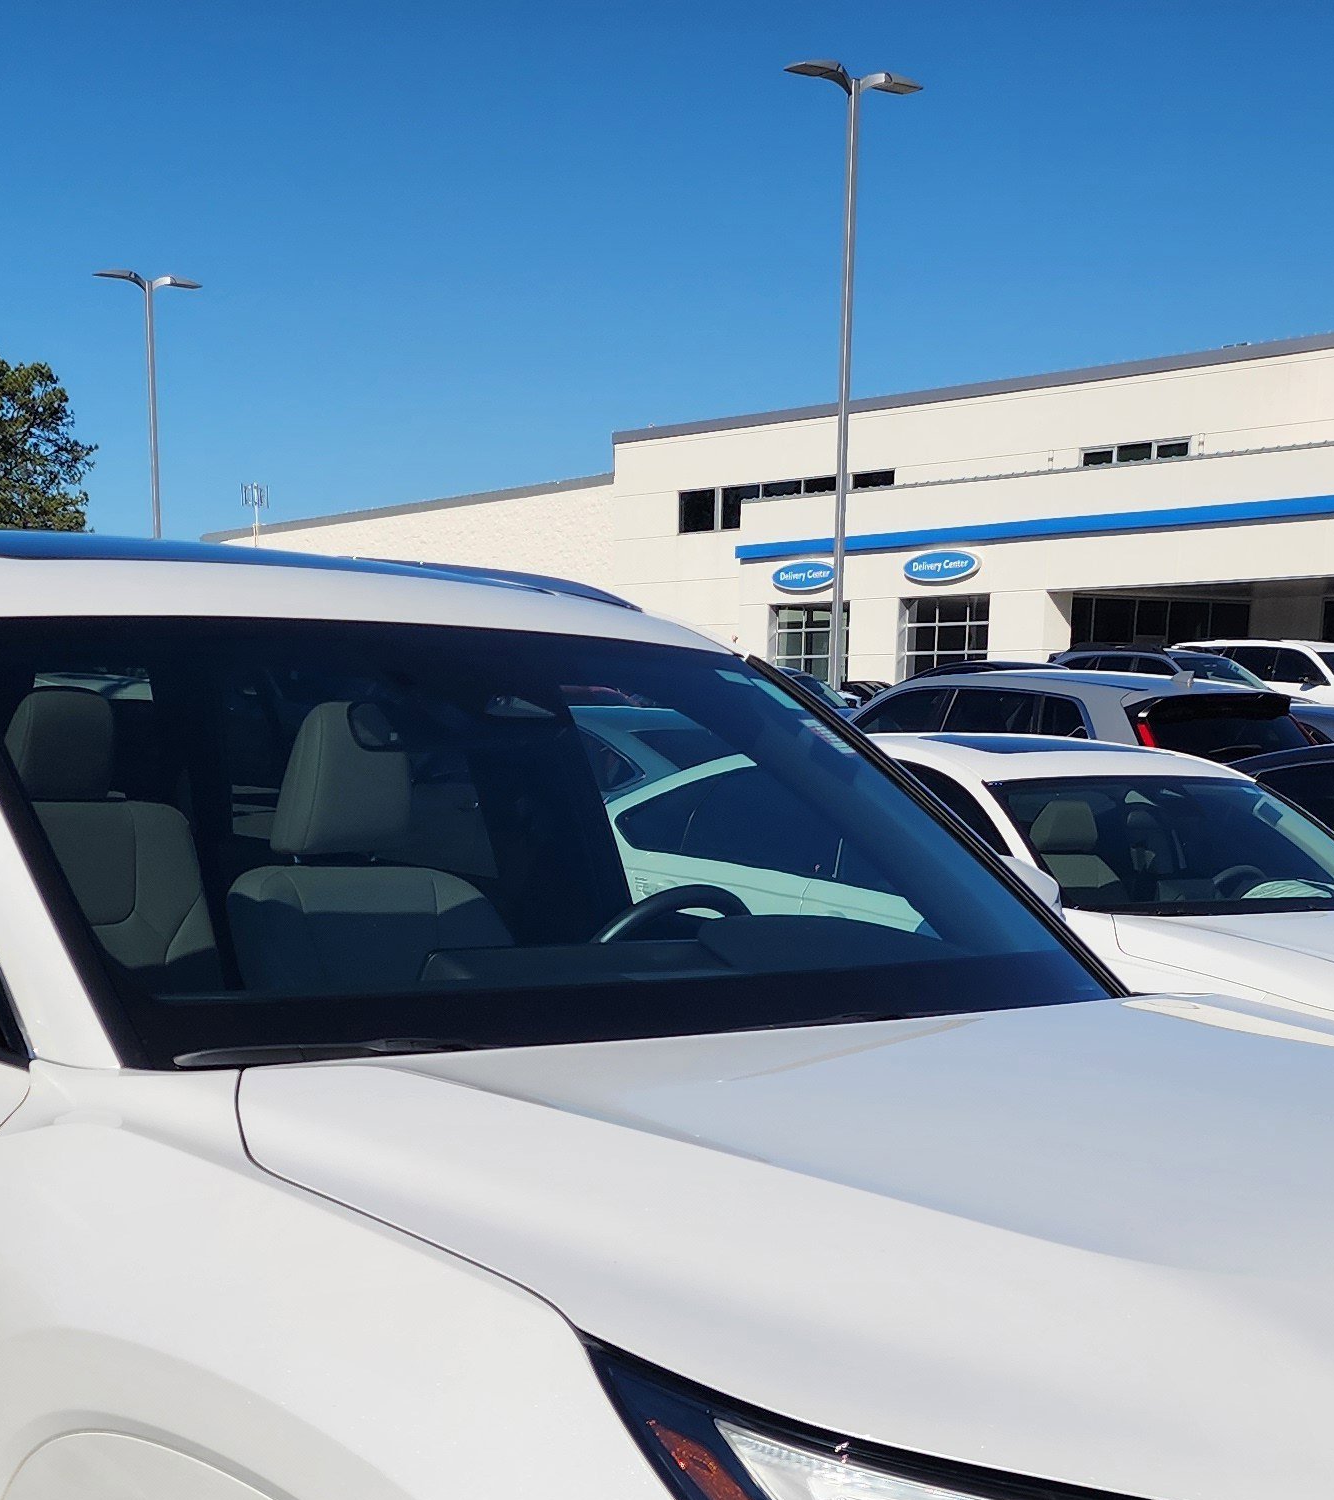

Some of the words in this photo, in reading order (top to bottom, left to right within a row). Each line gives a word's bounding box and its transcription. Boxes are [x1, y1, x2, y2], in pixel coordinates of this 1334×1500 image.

[912, 562, 943, 572] Delivery
[943, 559, 969, 568] Center
[779, 571, 807, 582] Delivery
[807, 569, 831, 578] Center
